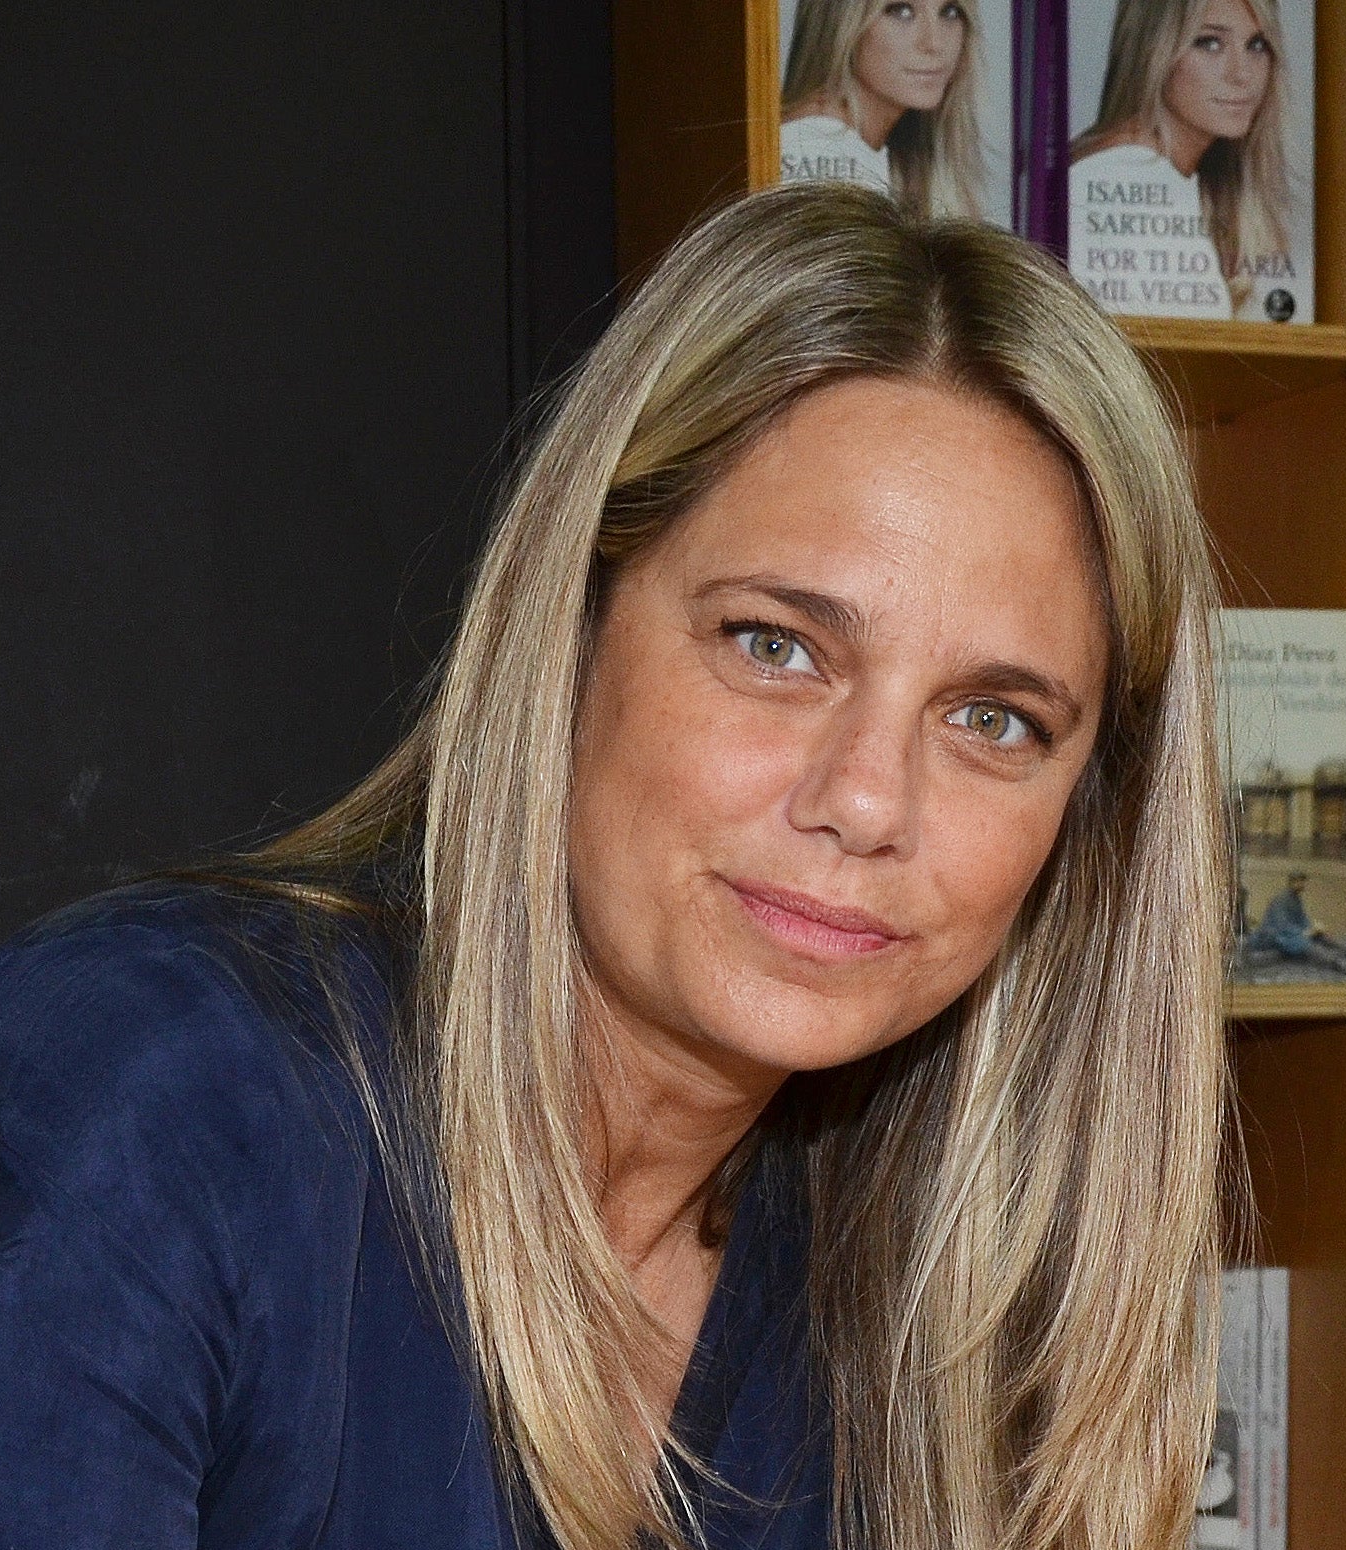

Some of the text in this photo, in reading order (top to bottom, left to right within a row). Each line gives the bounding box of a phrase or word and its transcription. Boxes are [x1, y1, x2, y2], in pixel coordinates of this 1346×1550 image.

[780, 153, 860, 180] SABEL
[1087, 180, 1175, 206] ISABEL
[1087, 248, 1137, 272] POR
[1144, 249, 1170, 273] TI
[1177, 251, 1212, 275] LO
[1088, 278, 1222, 305] MIL VECES
